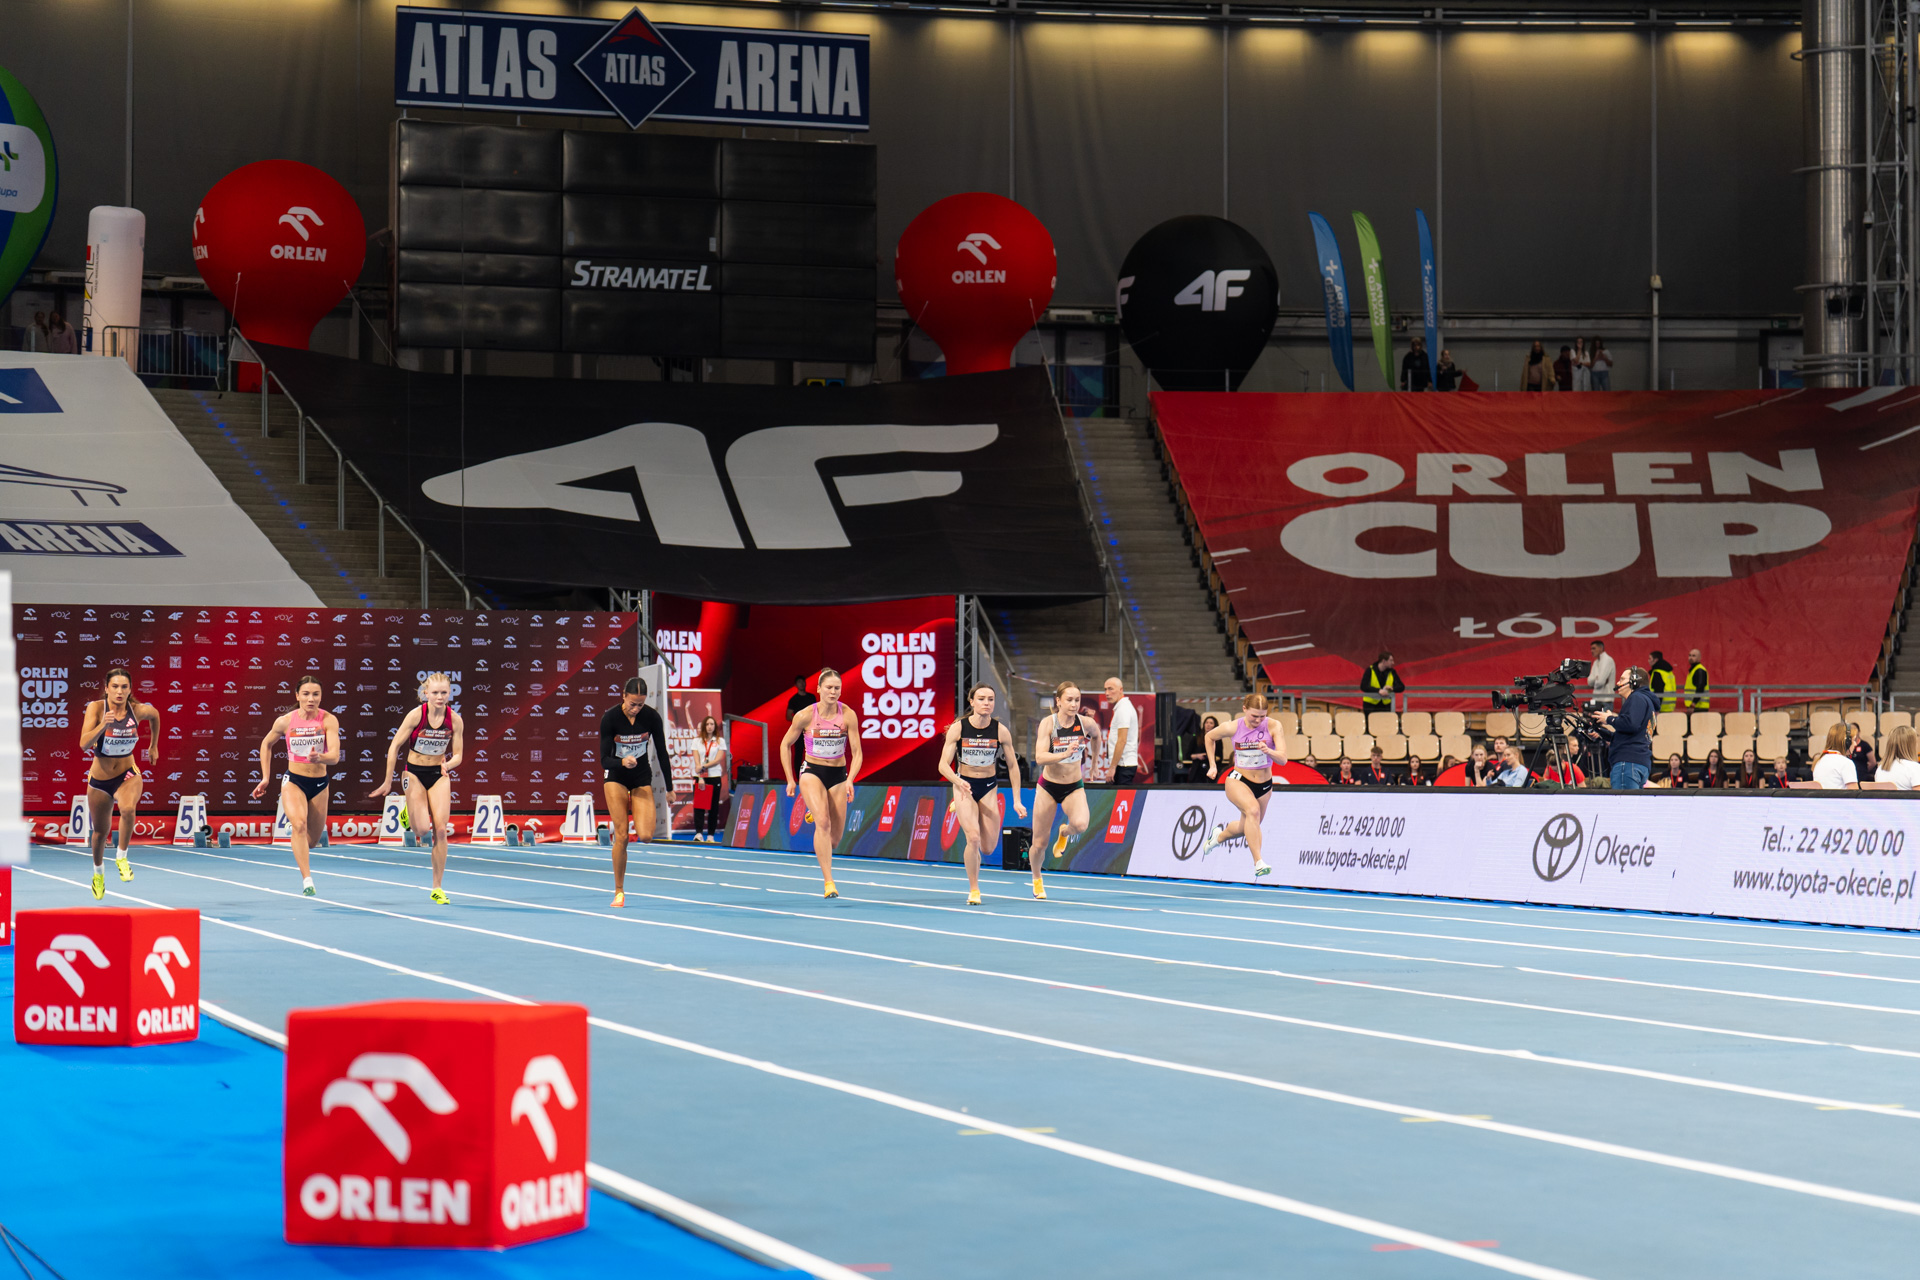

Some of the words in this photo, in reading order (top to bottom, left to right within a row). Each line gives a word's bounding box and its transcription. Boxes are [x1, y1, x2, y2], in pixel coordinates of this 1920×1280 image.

[407, 21, 557, 100] ATLAS
[715, 40, 861, 116] ARENA
[604, 53, 666, 86] ATLAS
[270, 244, 327, 262] ORLEN
[570, 260, 712, 291] STRAMATEL
[952, 270, 1006, 284] ORLEN
[1174, 269, 1251, 312] 4F
[421, 422, 999, 549] 4F
[1286, 448, 1824, 498] ORLEN
[10, 523, 160, 554] ARENA
[1280, 501, 1832, 579] CUP
[1453, 612, 1659, 639] ŁÓDŹ
[656, 629, 702, 652] ORLEN
[862, 632, 936, 654] ORLEN
[20, 667, 68, 678] ORLEN
[861, 654, 936, 689] CUP
[21, 680, 68, 699] CUP
[862, 688, 935, 716] ŁÓDŹ
[22, 699, 68, 715] ŁÓDŹ
[168, 704, 183, 712] 4F
[332, 705, 347, 713] 4F
[556, 707, 570, 715] 4F
[22, 717, 69, 728] 2026
[861, 718, 936, 739] 2026
[291, 738, 324, 746] GUZOWSKA
[167, 772, 182, 780] 4F
[72, 805, 84, 834] 6
[180, 805, 194, 834] 5
[386, 805, 399, 834] 3
[476, 805, 489, 834] 2
[493, 805, 502, 834] 2
[571, 804, 579, 833] 1
[586, 804, 592, 833] 1
[1110, 825, 1124, 834] ORLEN
[1318, 814, 1338, 835] Tel.:
[1339, 816, 1352, 836] 22
[1354, 816, 1374, 837] 492
[1374, 816, 1390, 837] 00
[1390, 817, 1406, 838] 00
[1594, 836, 1656, 873] Okęcie
[1762, 826, 1794, 852] Tel.:
[1796, 827, 1816, 853] 22
[1820, 828, 1852, 855] 492
[1856, 830, 1878, 856] 00
[1882, 830, 1904, 856] 00
[1299, 847, 1410, 875] www.toyota-okecie.pl
[1733, 866, 1917, 904] www.toyota-okecie.pl
[24, 1004, 117, 1032] ORLEN
[137, 1004, 195, 1036] ORLEN
[300, 1173, 470, 1226] ORLEN
[501, 1170, 584, 1231] ORLEN
